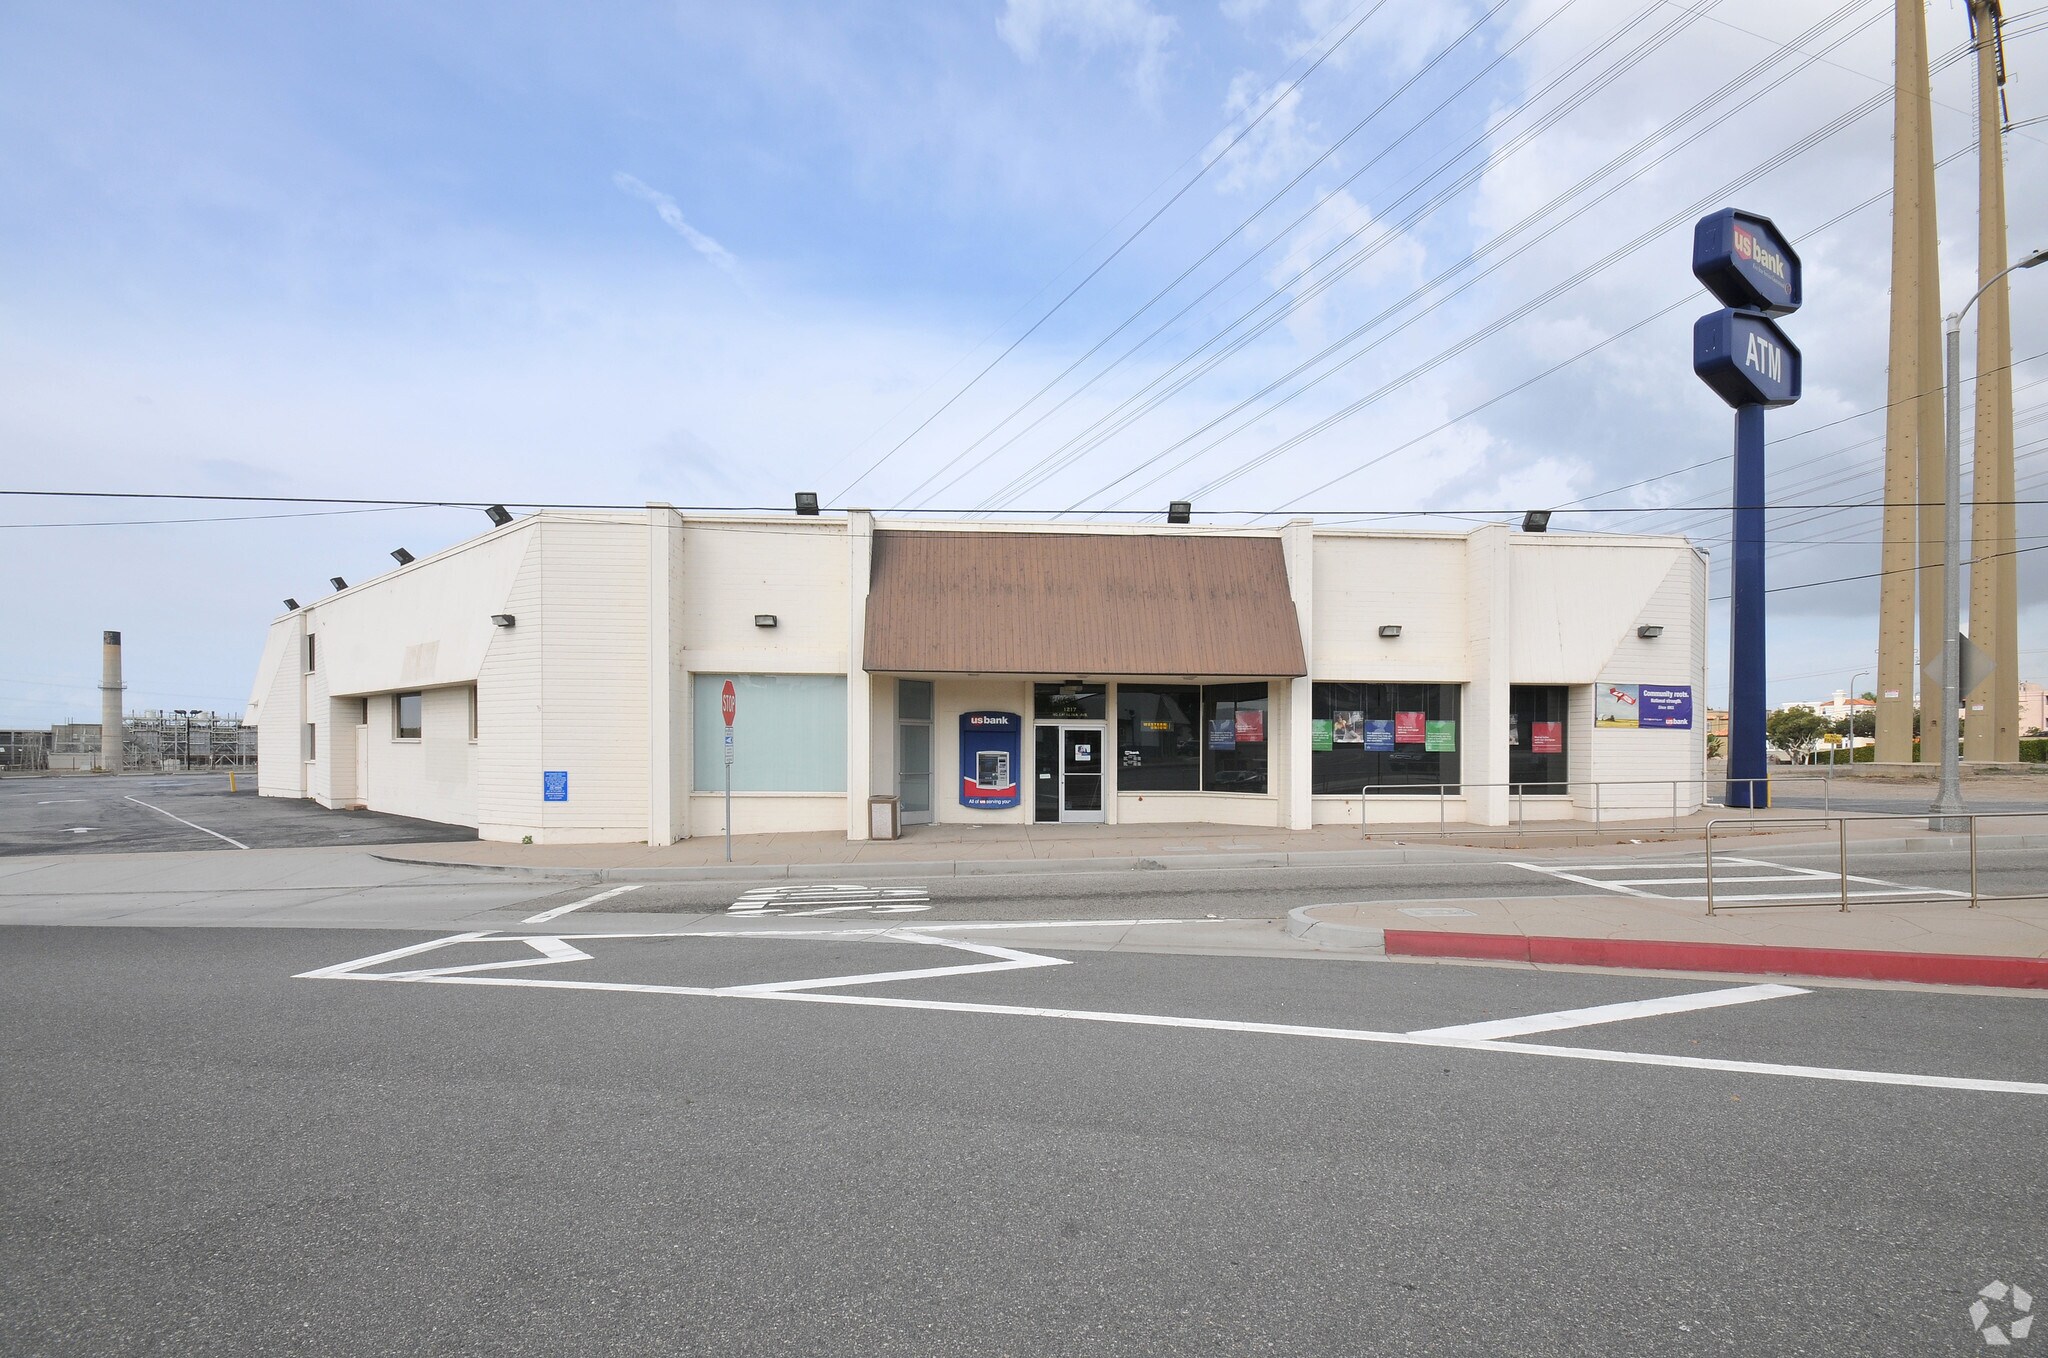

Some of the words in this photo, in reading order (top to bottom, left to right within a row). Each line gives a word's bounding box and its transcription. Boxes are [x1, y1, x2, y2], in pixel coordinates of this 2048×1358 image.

[1745, 332, 1781, 383] ATM
[1643, 690, 1673, 698] Community
[723, 694, 735, 713] STOP
[971, 716, 1008, 725] usbank
